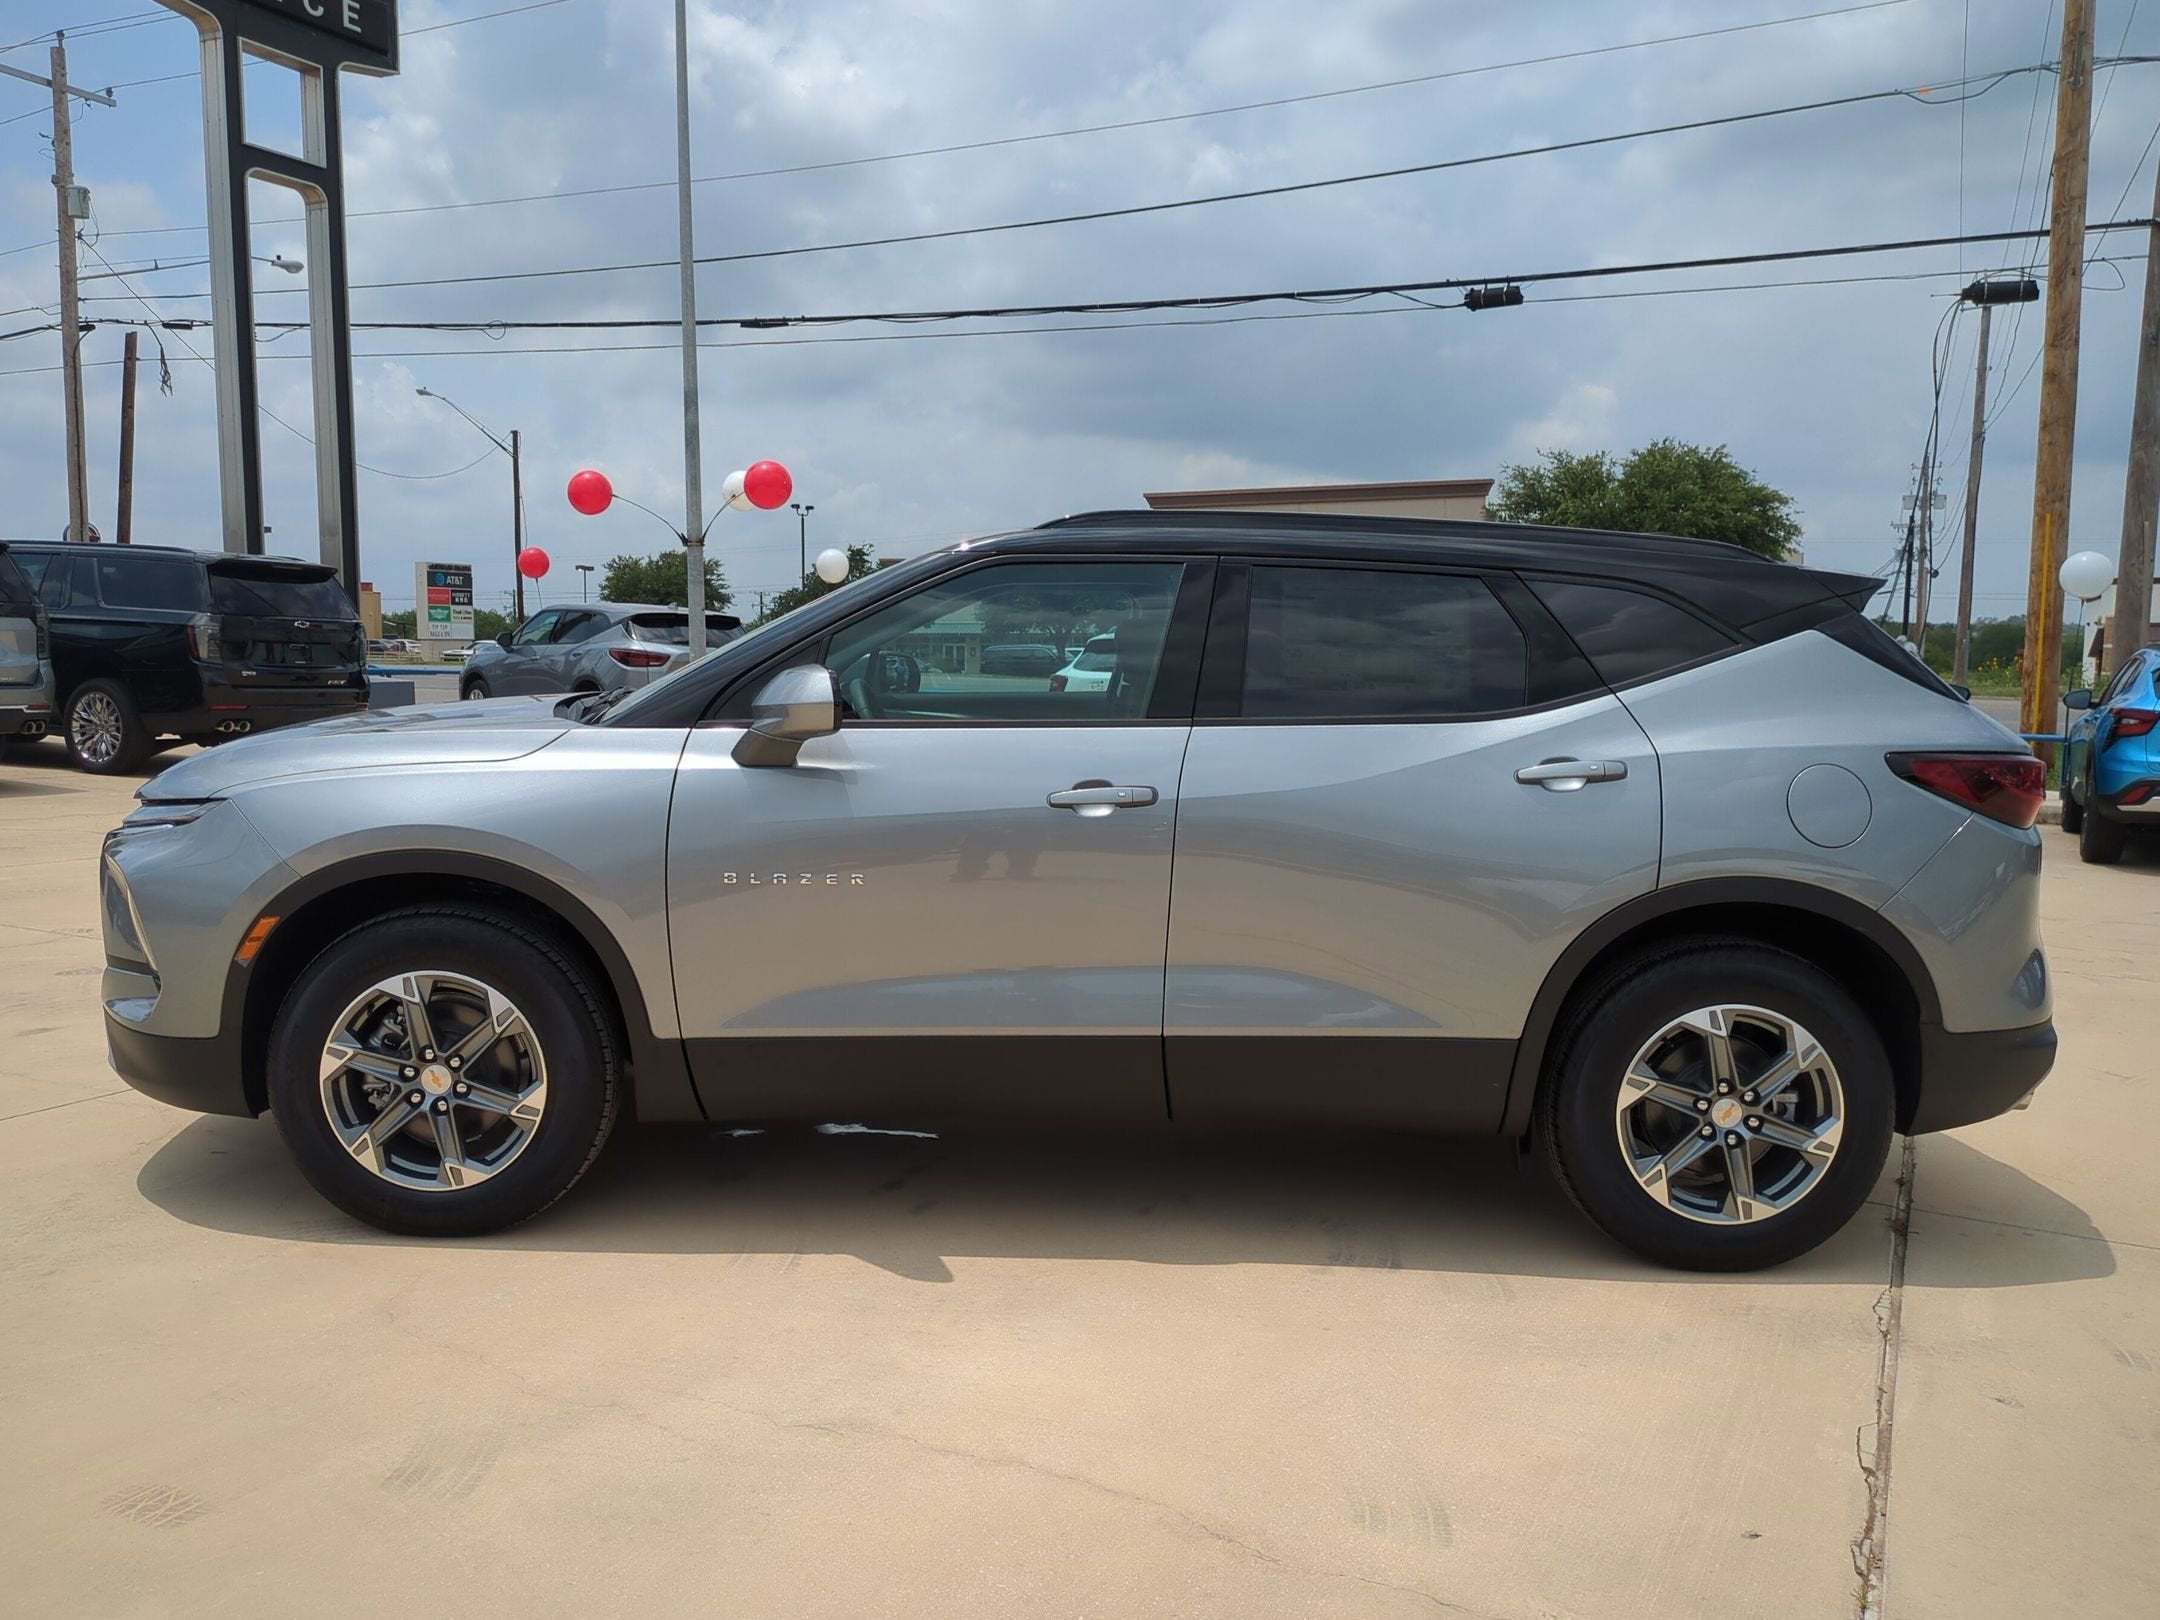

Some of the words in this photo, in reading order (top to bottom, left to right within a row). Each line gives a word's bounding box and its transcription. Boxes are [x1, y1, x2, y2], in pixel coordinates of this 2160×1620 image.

[278, 0, 362, 33] CE
[446, 576, 464, 585] AT&T
[723, 872, 864, 885] BLAZER
